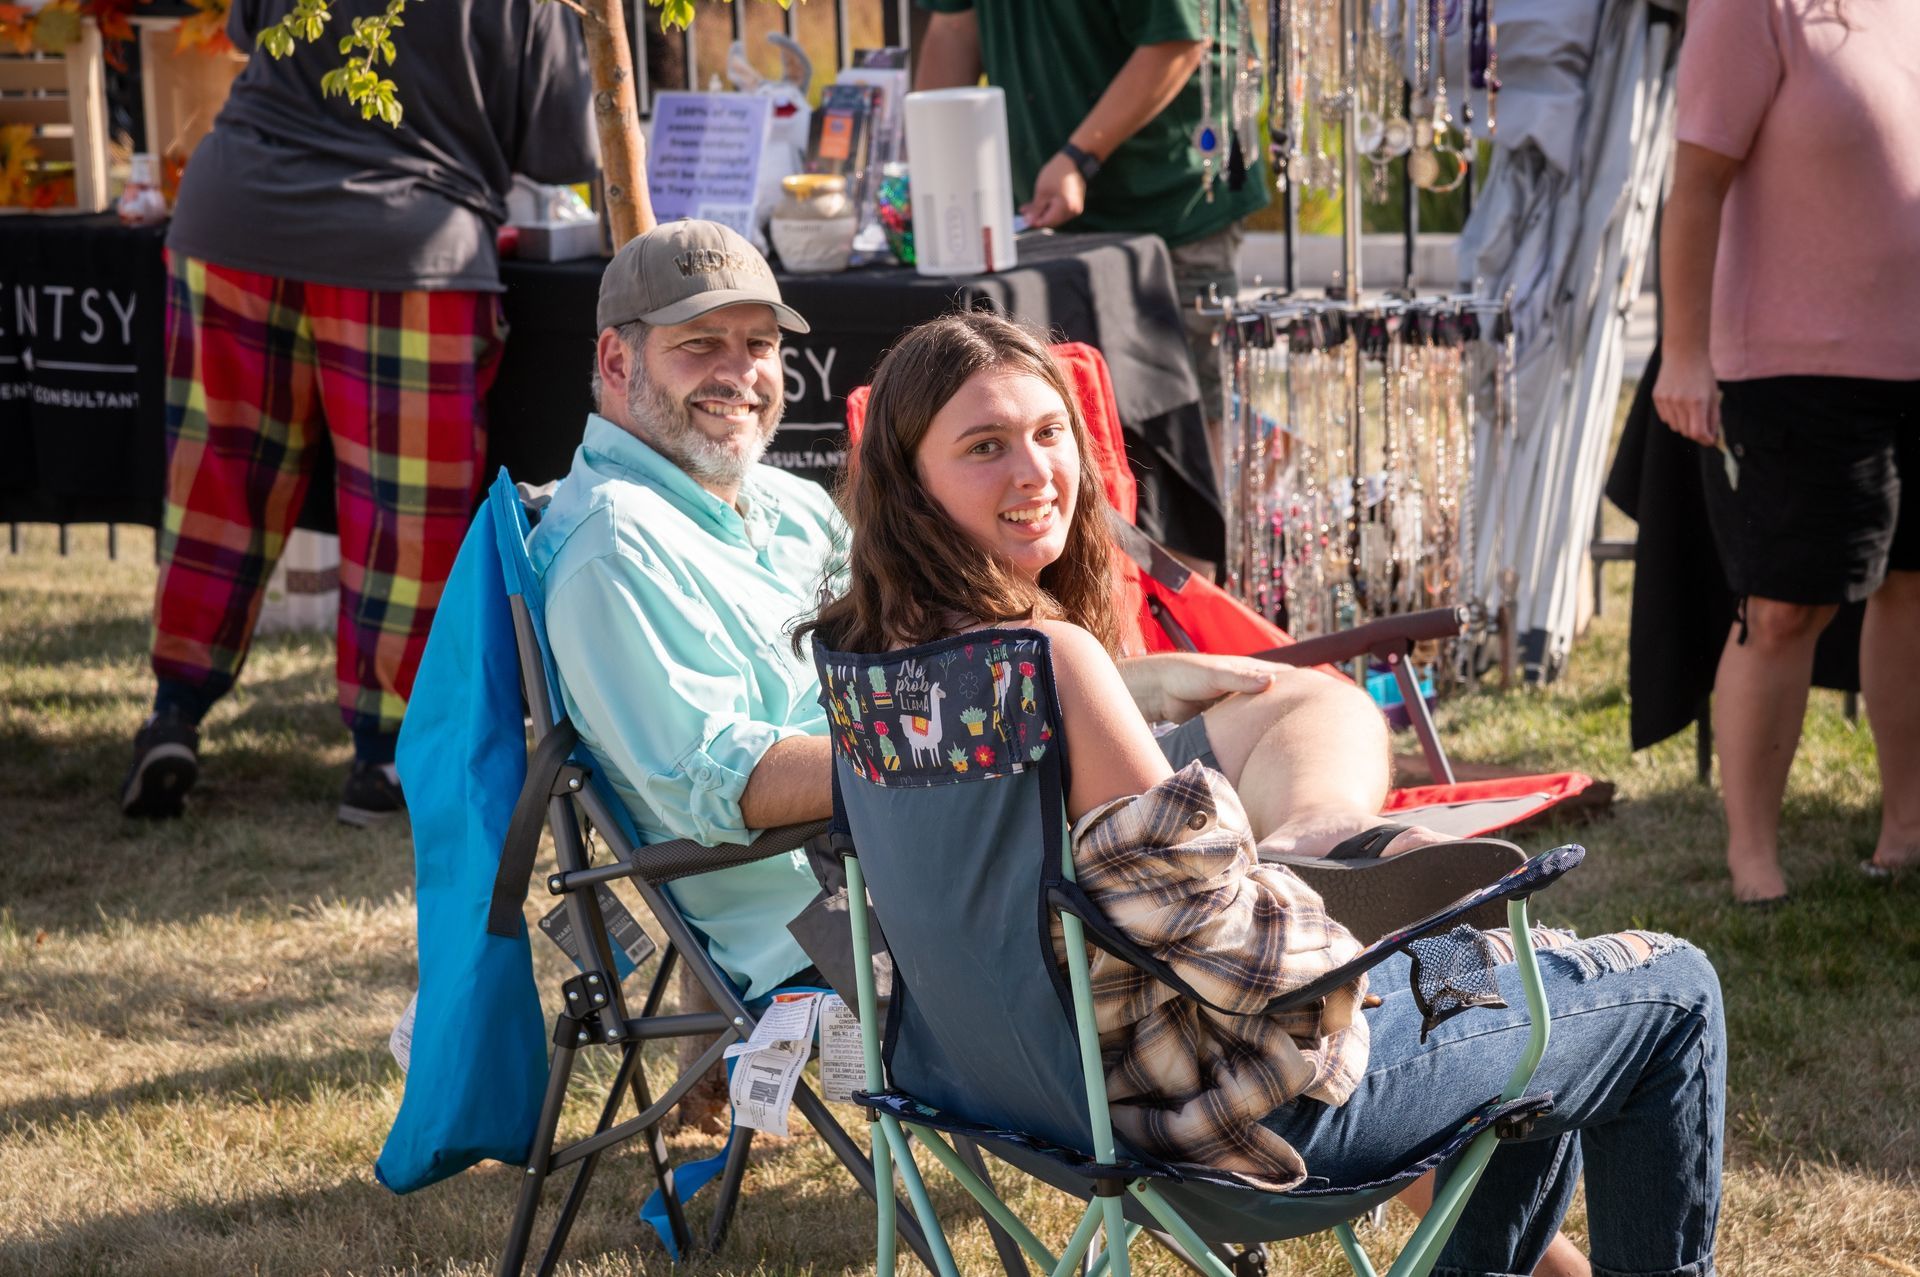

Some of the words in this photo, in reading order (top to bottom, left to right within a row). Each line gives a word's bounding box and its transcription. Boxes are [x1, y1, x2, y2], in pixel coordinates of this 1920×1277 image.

[0, 282, 138, 345] NTSY
[897, 659, 926, 678] No
[895, 675, 931, 696] prob
[900, 692, 929, 713] LLAMA
